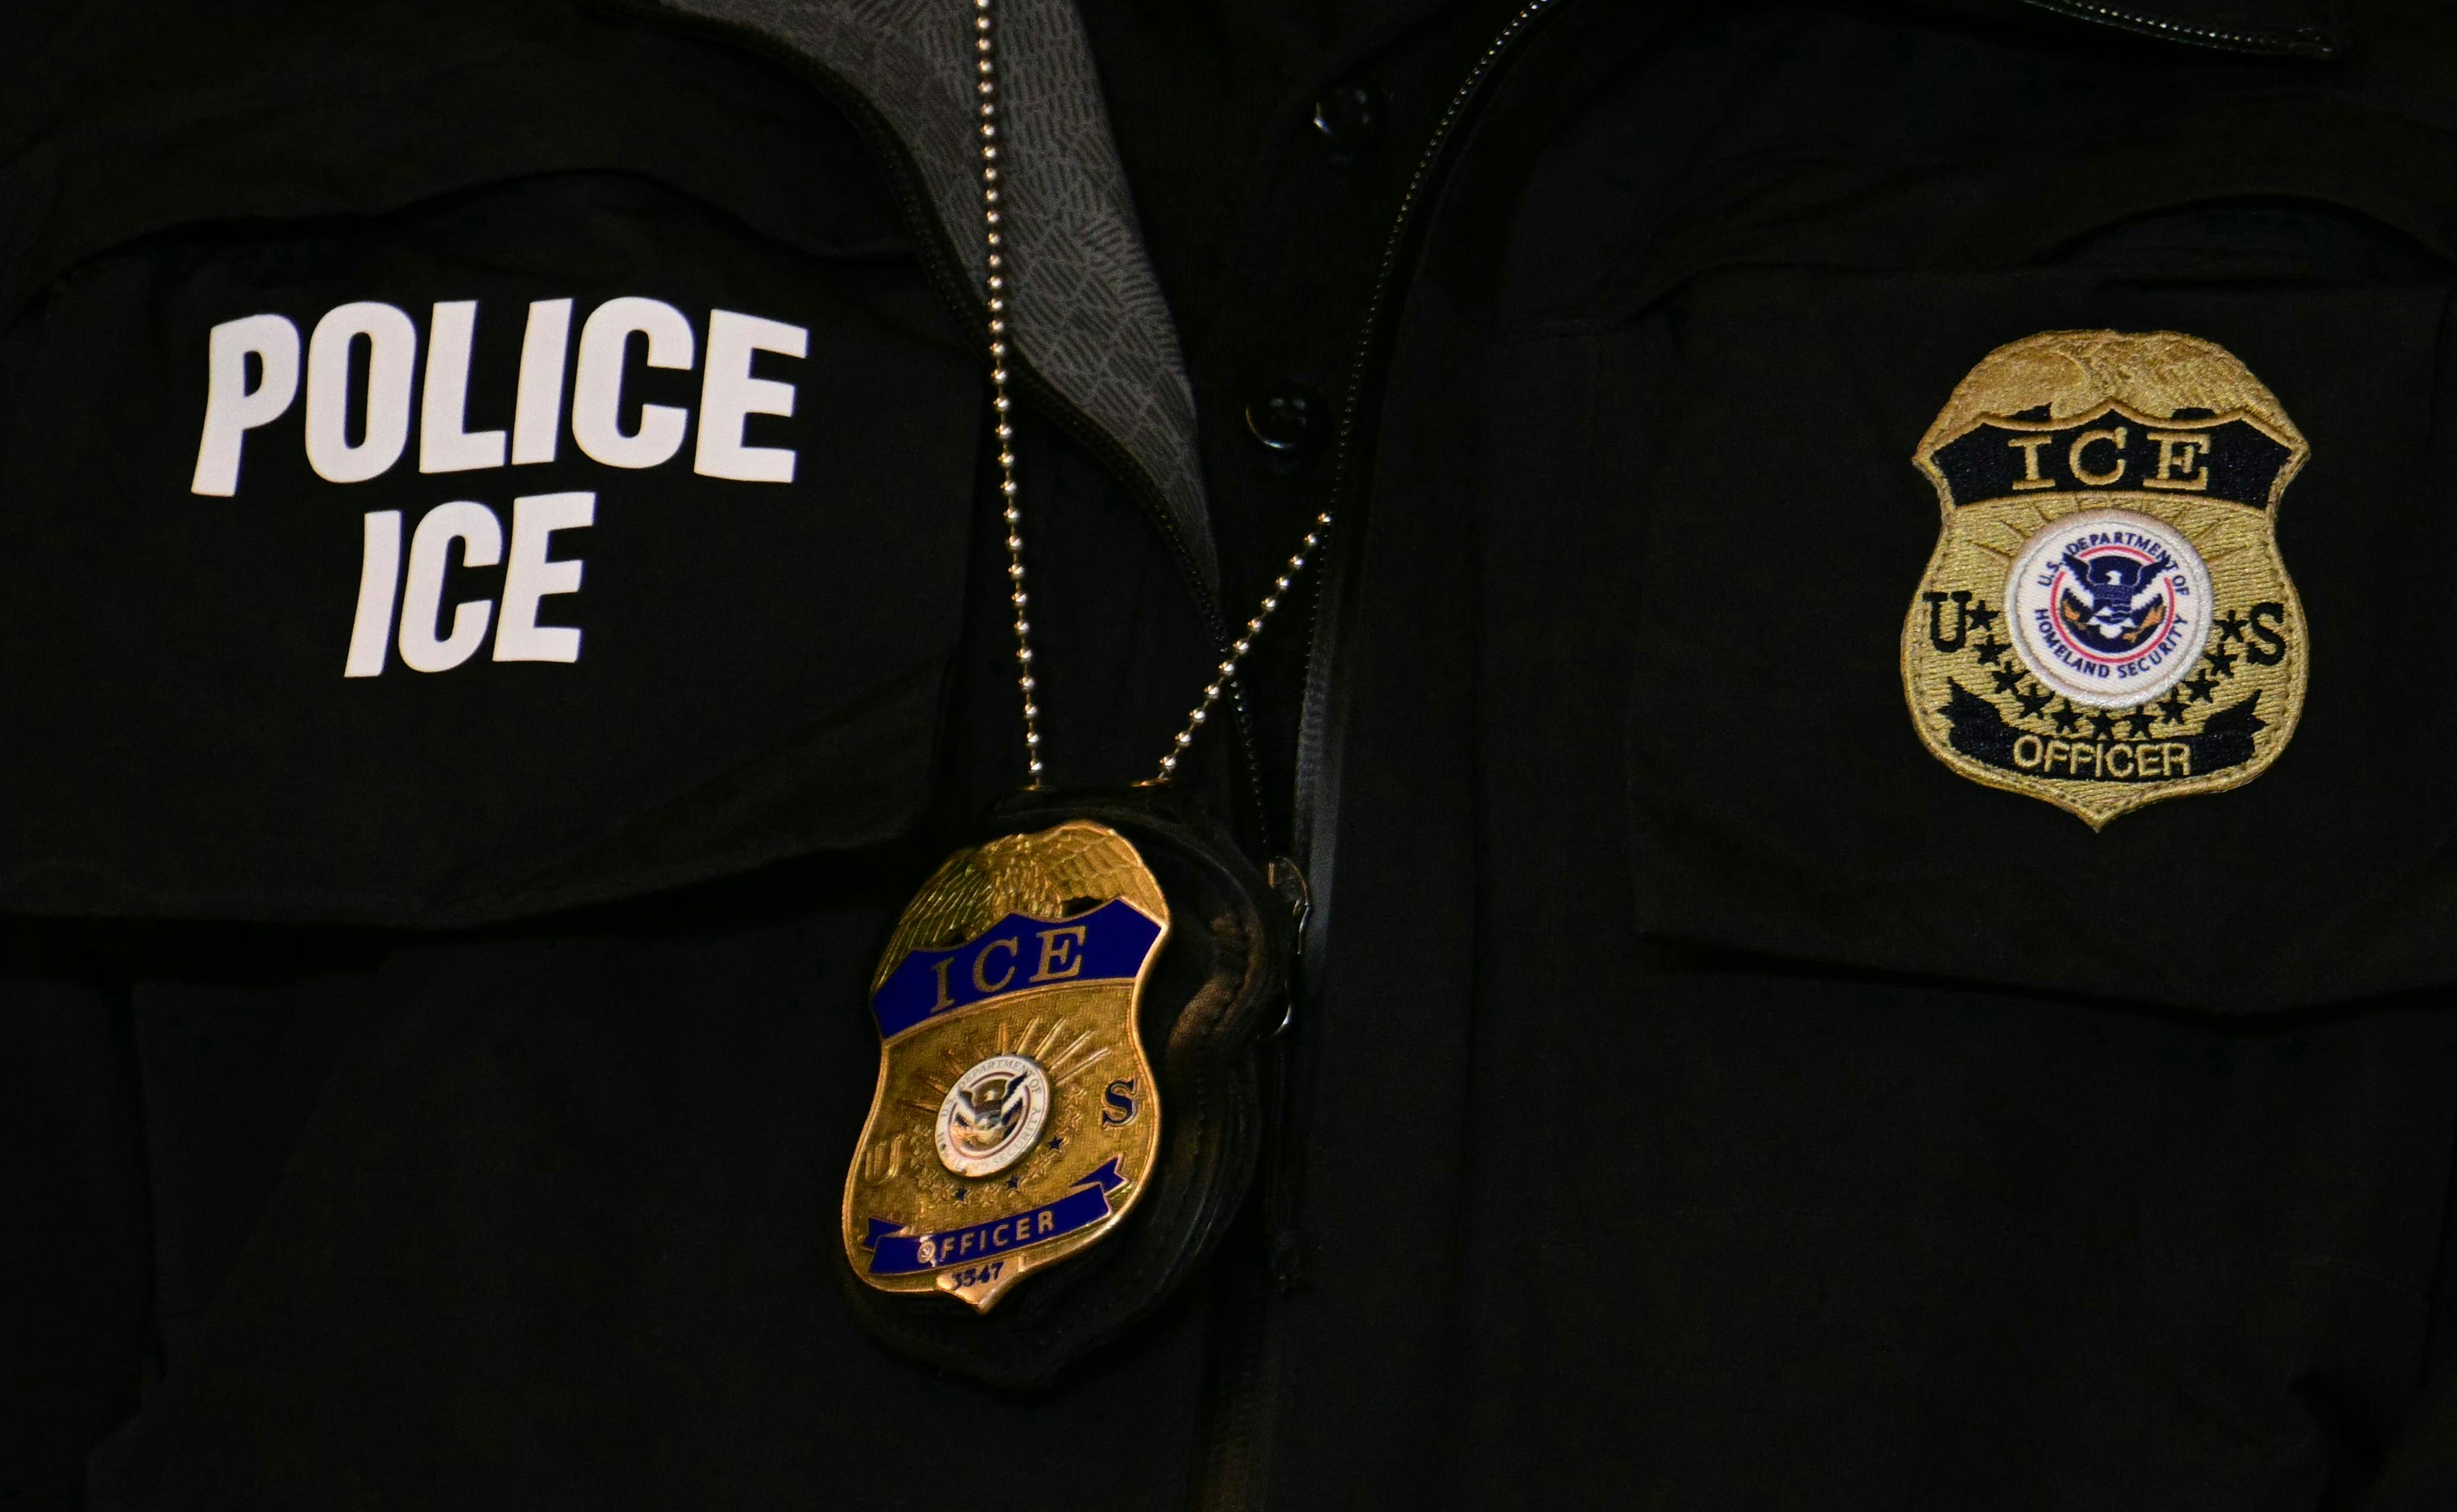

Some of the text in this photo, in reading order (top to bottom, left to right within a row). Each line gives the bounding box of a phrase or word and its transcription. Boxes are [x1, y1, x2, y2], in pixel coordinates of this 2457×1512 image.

[191, 297, 808, 497] POLICE
[2008, 427, 2210, 491] ICE
[345, 492, 596, 677] ICE
[2064, 532, 2179, 571] DEPARTMENT
[2172, 574, 2189, 596] OF
[1922, 590, 2287, 666] U S
[2035, 608, 2187, 679] HOMELAND SECURITY
[2013, 734, 2191, 777] OFFICER
[931, 925, 1086, 1014] ICE
[1102, 1078, 1138, 1128] S
[917, 1211, 1054, 1263] OFFICER
